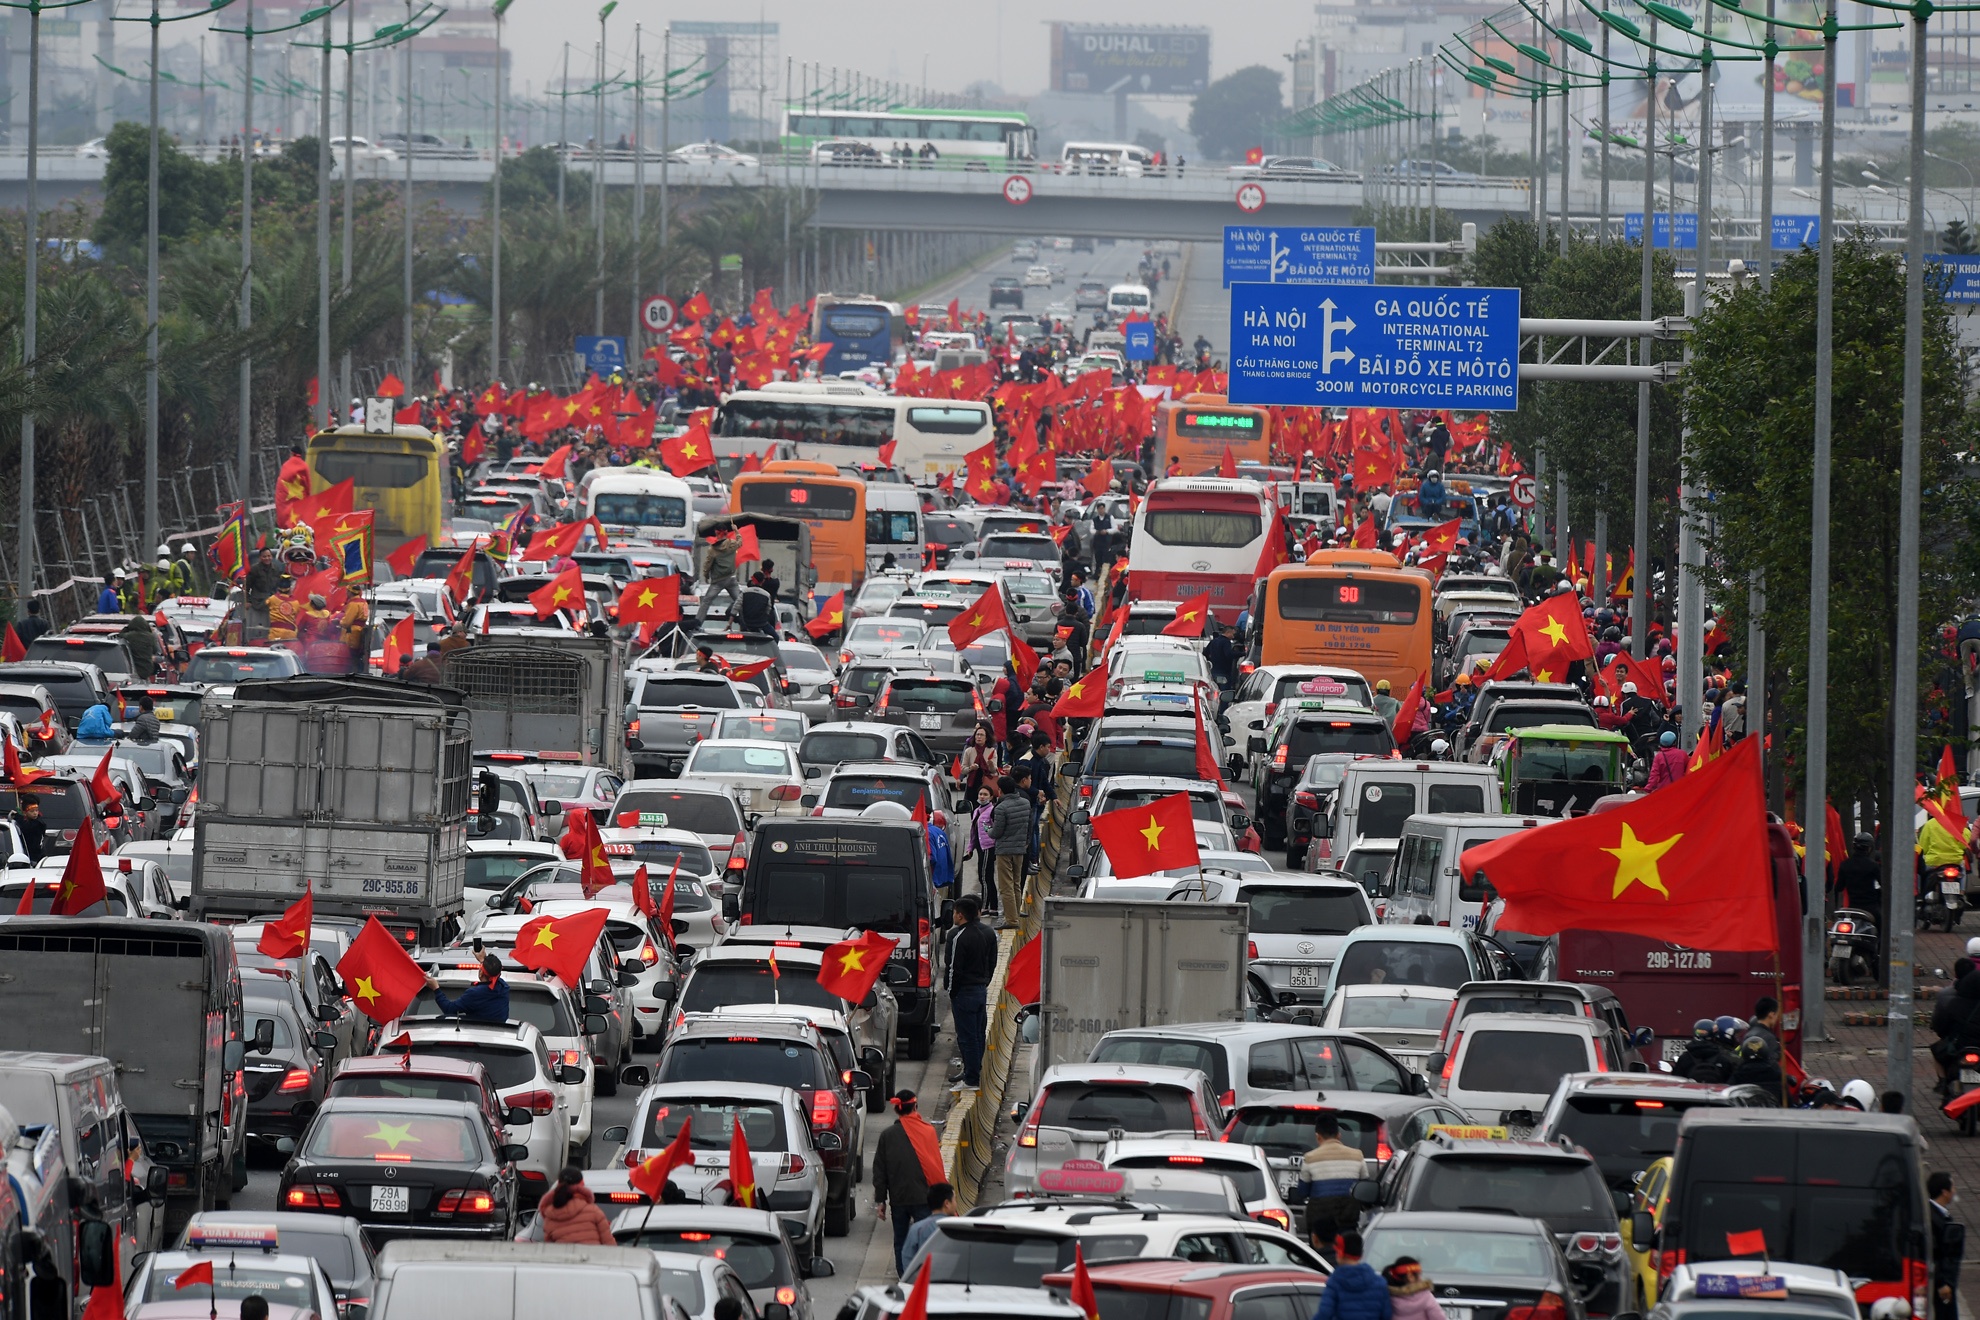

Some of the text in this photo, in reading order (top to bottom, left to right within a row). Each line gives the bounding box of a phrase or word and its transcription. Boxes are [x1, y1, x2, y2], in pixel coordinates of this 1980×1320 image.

[1084, 35, 1198, 54] DUHAL LED
[1231, 229, 1264, 242] HÀ NỘI
[1301, 228, 1361, 242] GA QUỐC TẾ
[1290, 261, 1370, 275] BÃI ĐỖ XE MÔTÔ
[1375, 294, 1490, 318] GA QUỐC TẾ
[650, 306, 668, 322] 60
[1244, 306, 1306, 331] HÀ NỘI
[1383, 324, 1489, 337] INTERNATIONAL
[1252, 335, 1296, 347] HA NOI
[1396, 339, 1483, 352] TERMINAL T2
[1259, 358, 1290, 369] THĂNG
[1292, 361, 1318, 369] LONG
[1359, 352, 1511, 379] BÃI ĐỖ XE MÔTÔ
[1362, 382, 1452, 395] MOTORCYCLE
[1456, 384, 1513, 397] PARKING
[790, 489, 807, 504] 90
[1340, 586, 1359, 603] 90
[1362, 625, 1380, 633] VIÊN
[612, 844, 633, 853] 123
[832, 844, 877, 852] LIMOUSINE
[363, 879, 418, 894] 29C-955.86
[1647, 952, 1711, 969] 29B-127.86
[1297, 968, 1312, 976] 30E
[1291, 977, 1317, 985] 358.11
[1464, 1129, 1488, 1139] LONG
[1064, 1176, 1120, 1189] AIRPORT
[380, 1188, 400, 1198] 29A
[373, 1199, 406, 1211] 759.98
